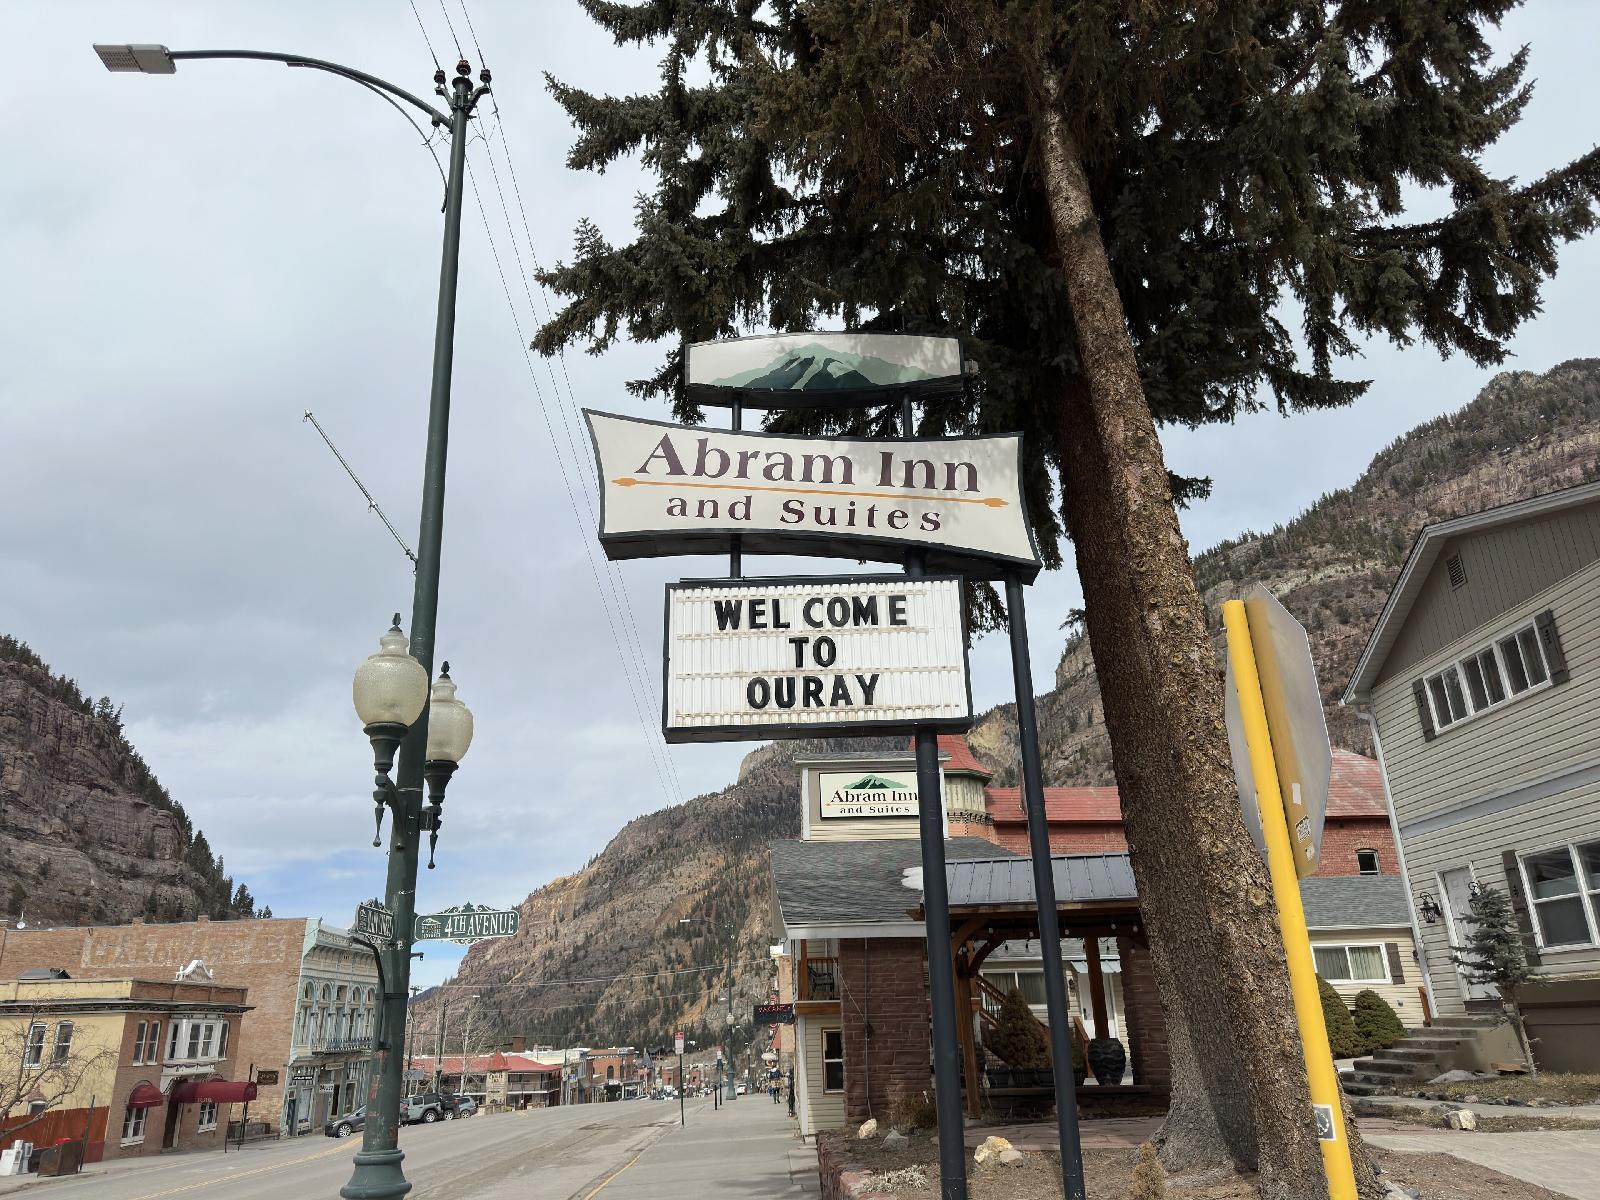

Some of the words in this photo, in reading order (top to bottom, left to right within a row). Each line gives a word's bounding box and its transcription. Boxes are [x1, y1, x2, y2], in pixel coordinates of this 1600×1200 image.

[634, 432, 855, 485] Abram
[876, 451, 980, 492] Inn
[666, 495, 752, 521] and
[780, 499, 941, 532] Suites
[714, 595, 907, 630] WELCOME
[789, 636, 836, 668] TO
[747, 673, 880, 709] OURAY
[830, 790, 886, 803] Abram
[892, 791, 918, 802] Inn
[840, 806, 863, 814] and
[869, 805, 910, 814] Suites
[444, 916, 466, 937] 4TH
[467, 912, 515, 936] AVENUE
